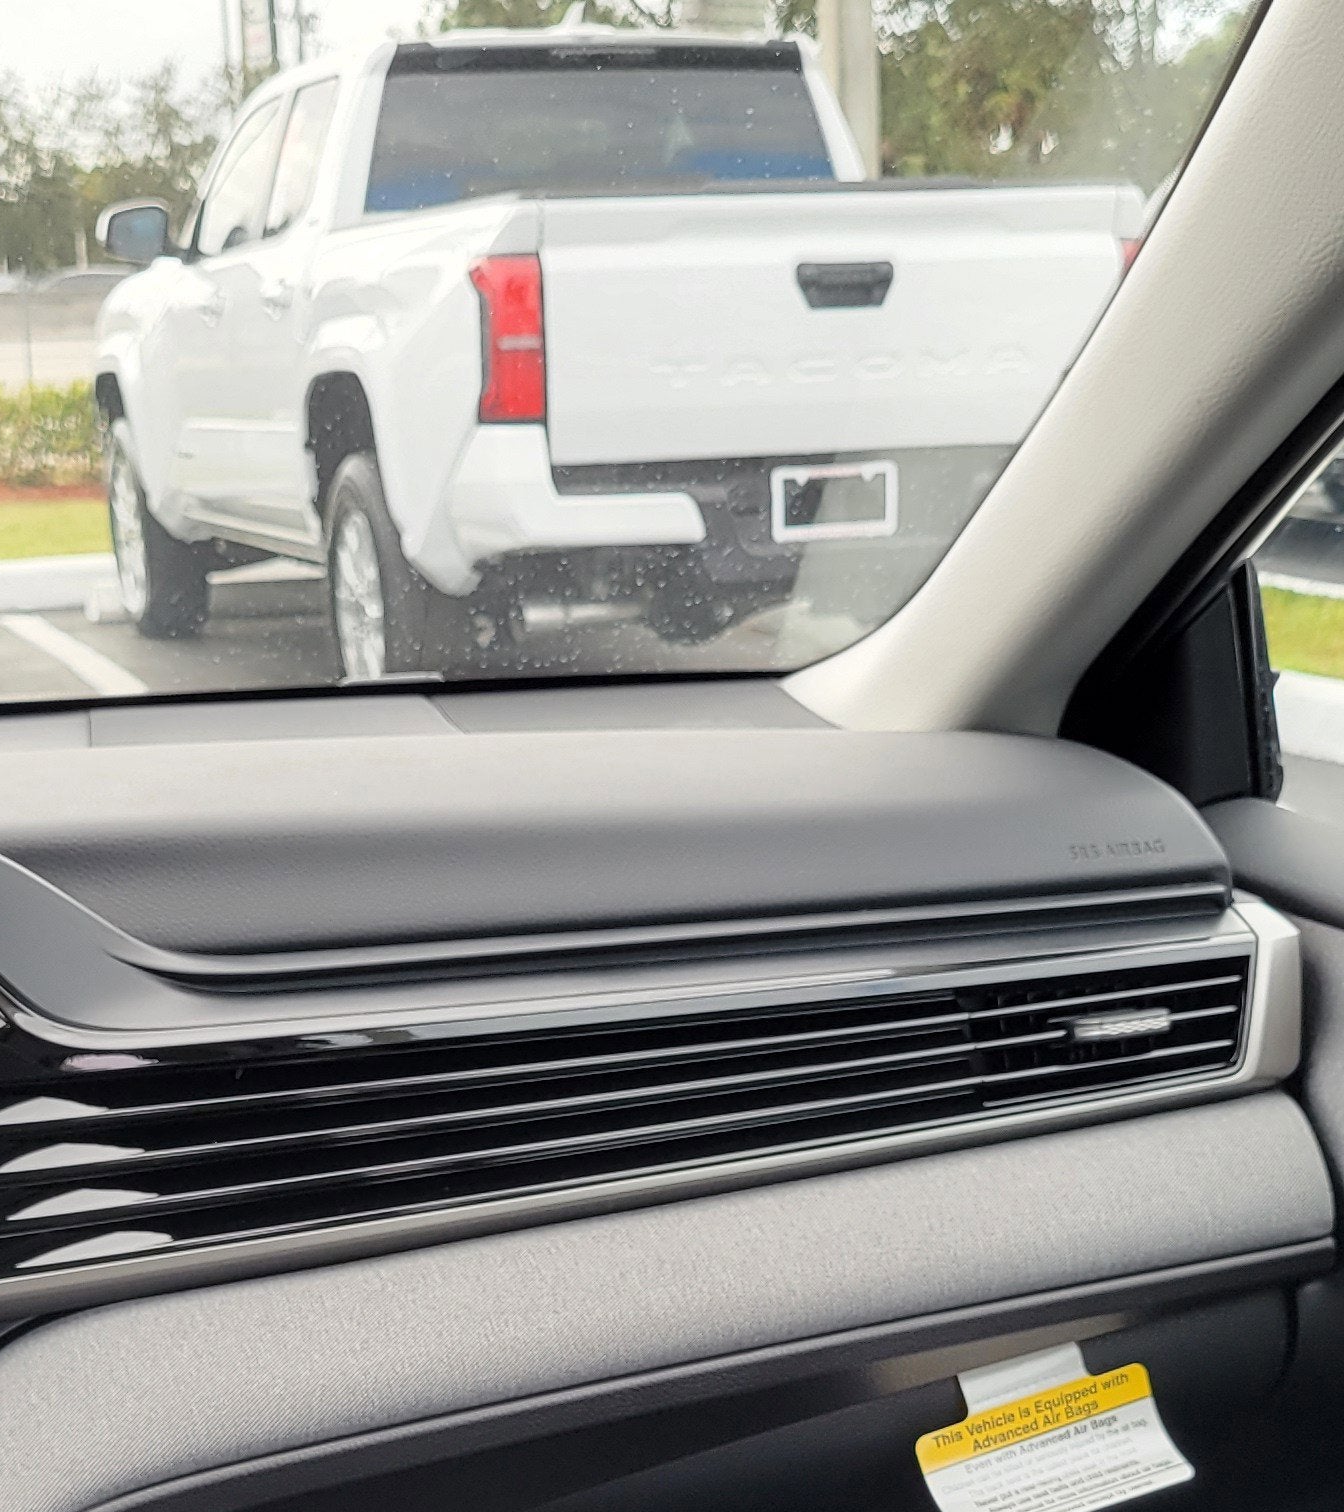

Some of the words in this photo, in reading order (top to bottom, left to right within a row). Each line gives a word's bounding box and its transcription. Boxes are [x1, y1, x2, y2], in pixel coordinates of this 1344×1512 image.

[931, 1430, 964, 1450] This
[965, 1412, 1016, 1435] Vehicle
[1034, 1383, 1098, 1415] Equipped
[1101, 1372, 1129, 1390] with
[971, 1421, 1040, 1452] Advanced
[1042, 1412, 1061, 1428] Air
[1065, 1399, 1099, 1420] Bags
[964, 1458, 994, 1475] Even
[994, 1450, 1018, 1466] with
[1019, 1430, 1072, 1456] Advanced
[1073, 1423, 1088, 1438] Air
[1091, 1413, 1119, 1431] Bags
